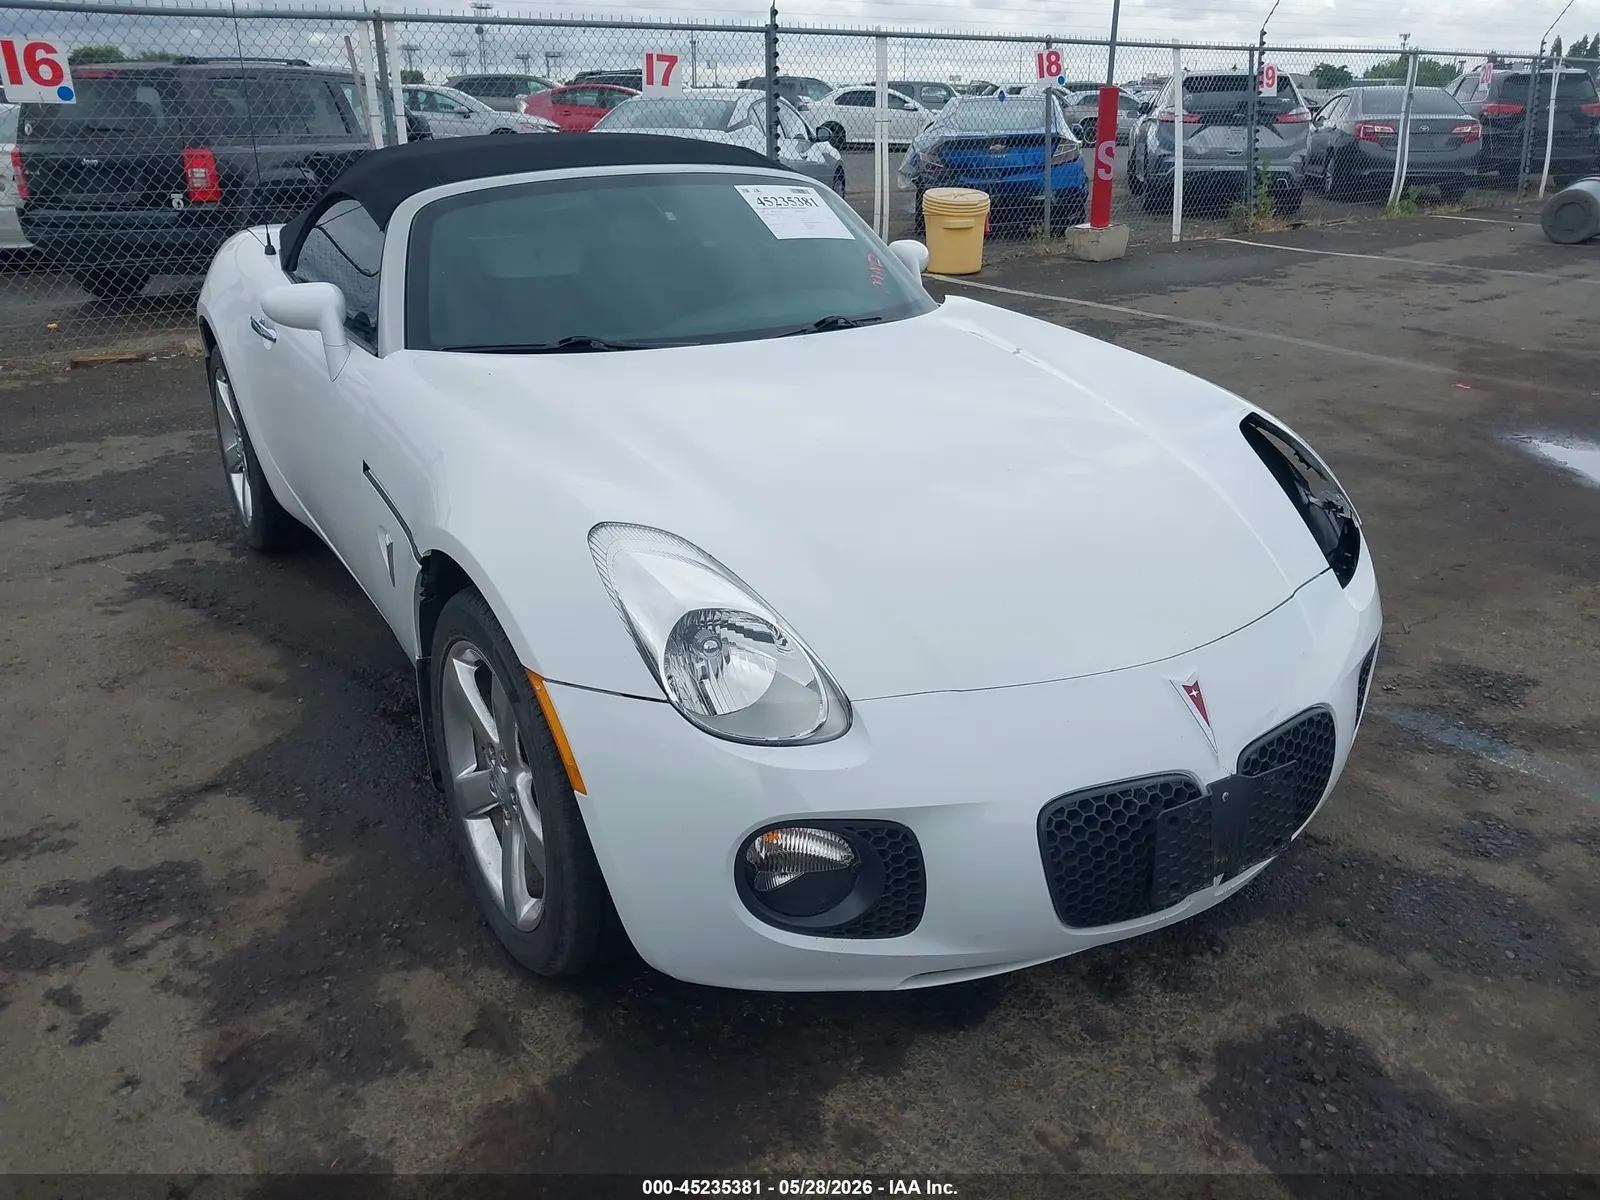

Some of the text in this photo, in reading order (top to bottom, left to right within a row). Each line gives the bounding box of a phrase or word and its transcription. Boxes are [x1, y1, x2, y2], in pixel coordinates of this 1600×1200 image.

[0, 40, 64, 87] 16
[645, 53, 678, 87] 17
[1037, 50, 1061, 79] 18
[1480, 64, 1491, 84] 20
[81, 157, 99, 168] Jeep
[1097, 140, 1116, 181] S
[756, 196, 820, 207] 45235381
